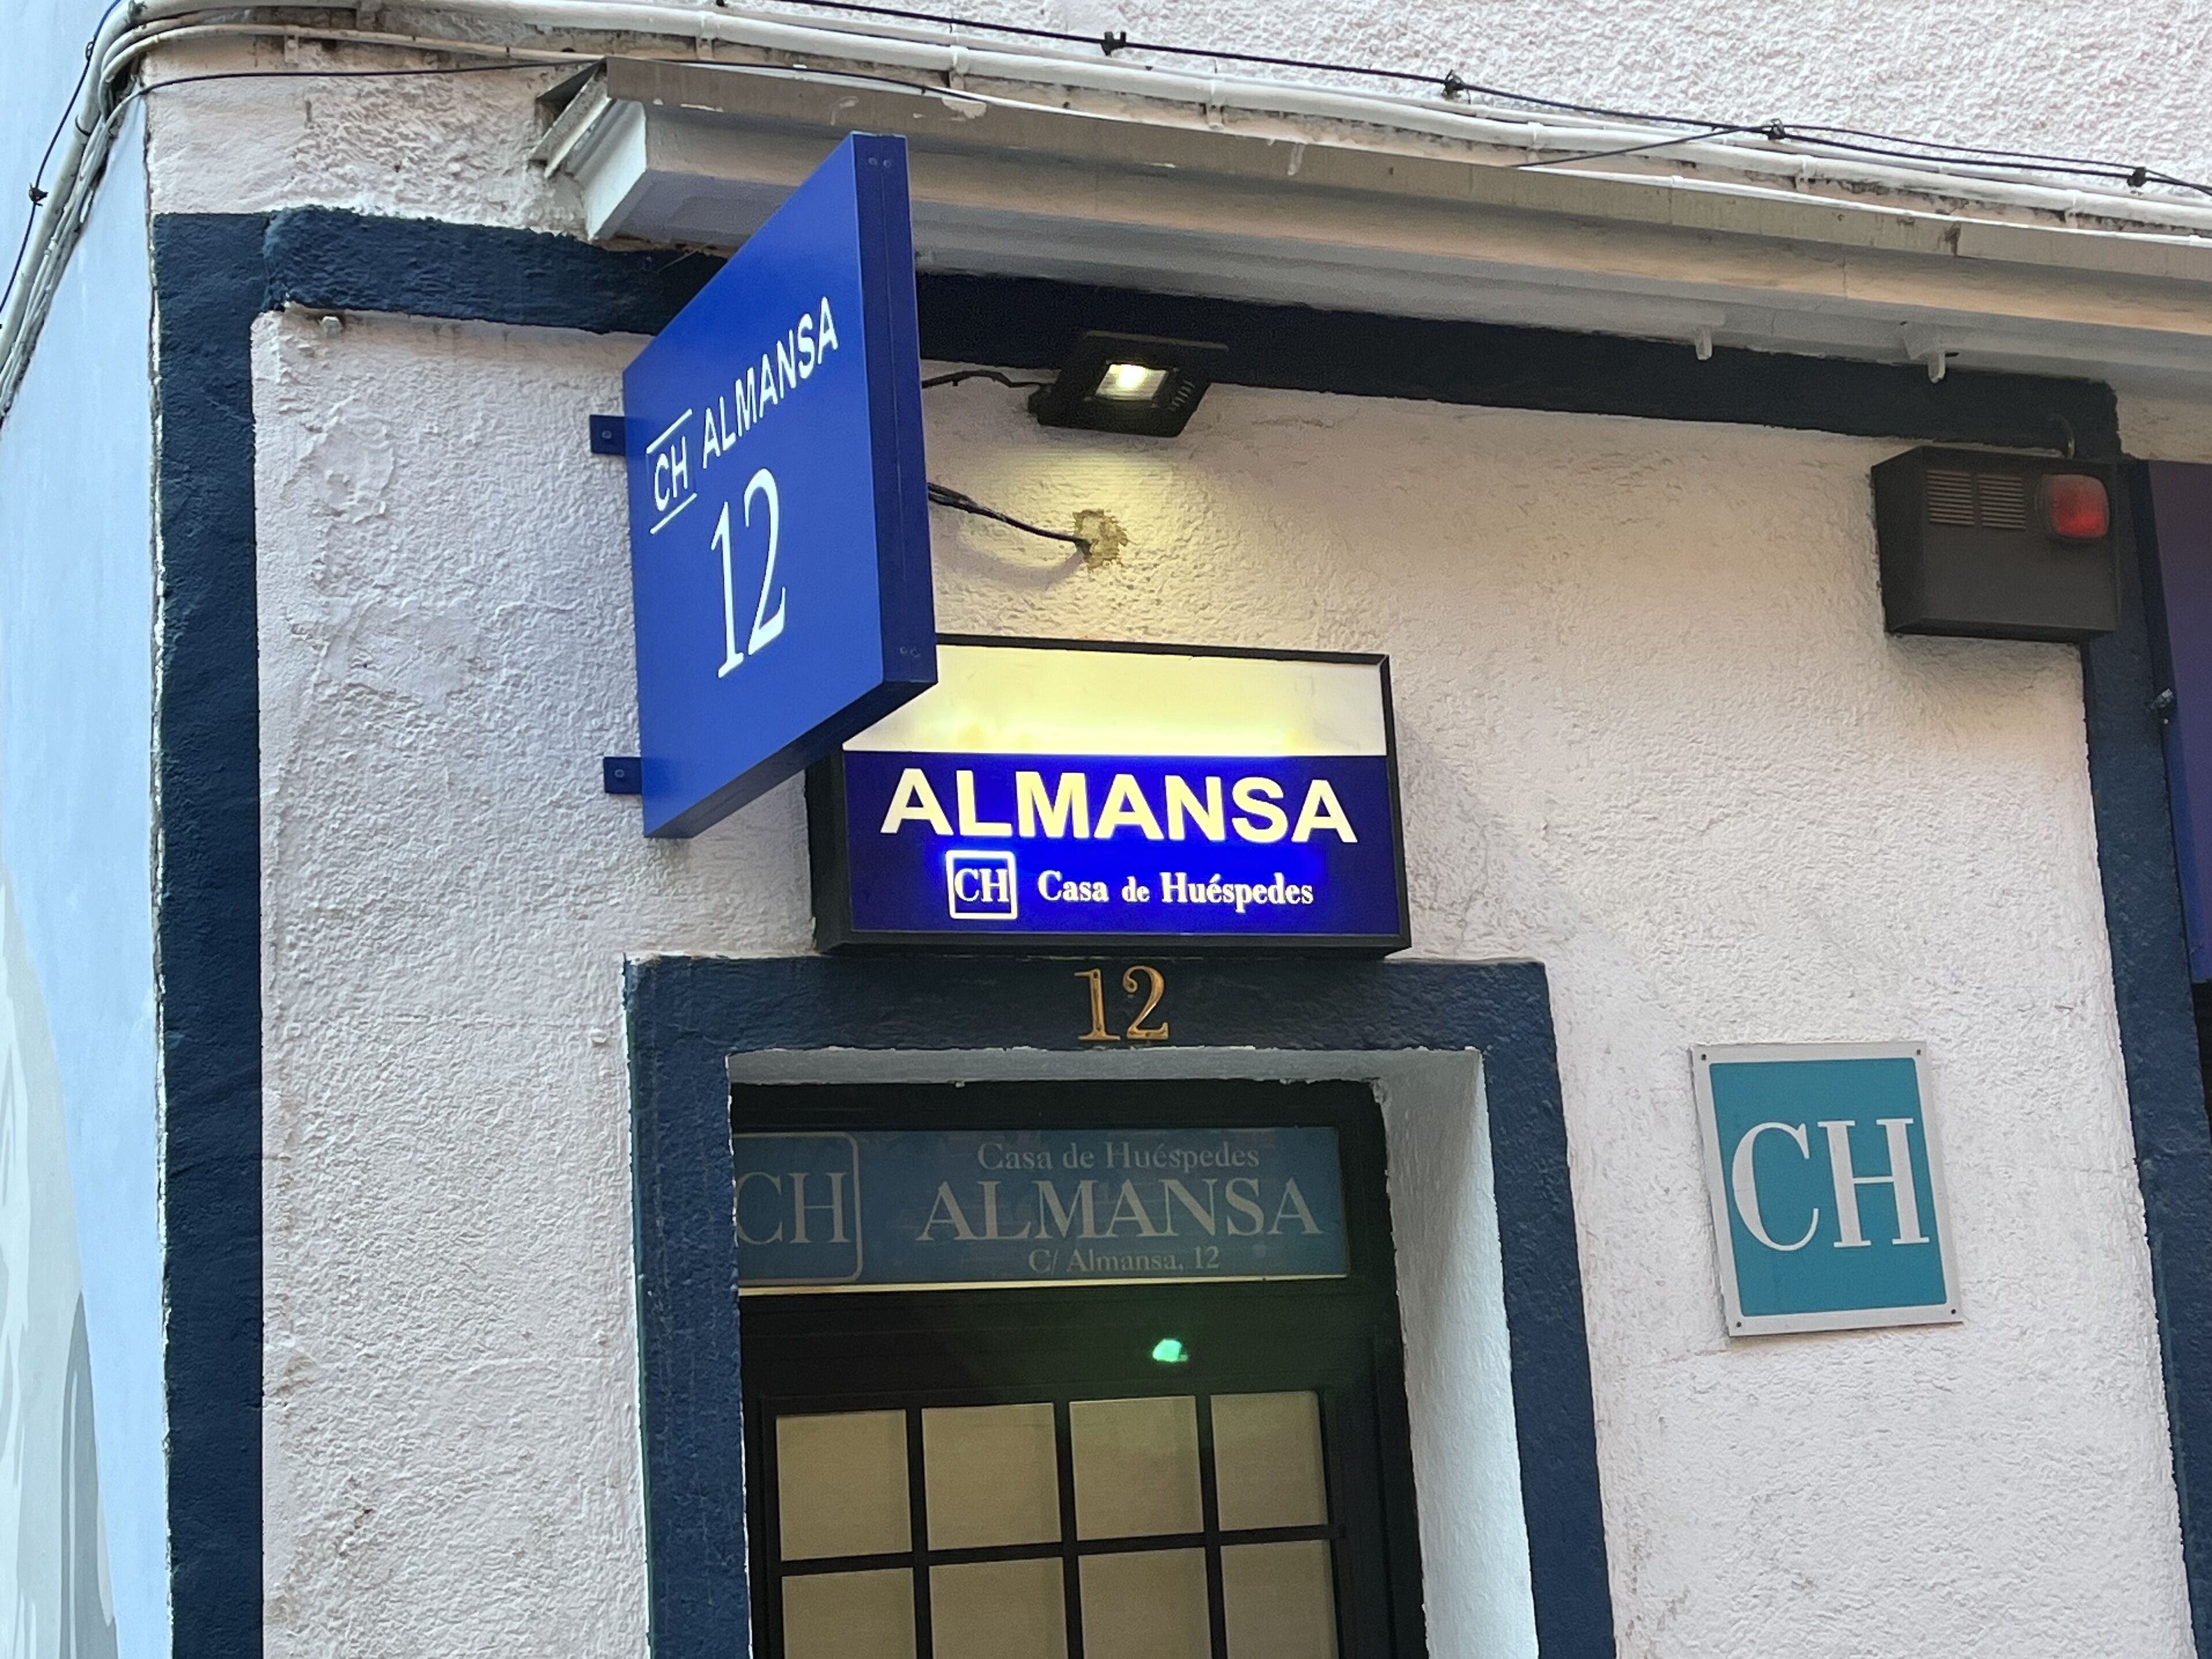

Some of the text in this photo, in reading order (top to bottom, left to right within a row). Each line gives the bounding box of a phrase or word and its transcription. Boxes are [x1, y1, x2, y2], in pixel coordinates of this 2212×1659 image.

[653, 297, 839, 511] CH ALMANSA
[711, 468, 787, 678] 12
[880, 768, 1358, 843] ALMANSA
[953, 868, 1010, 903] CH
[1037, 870, 1314, 914] Casa de Huéspedes
[1073, 964, 1170, 1040] 12
[977, 1141, 1260, 1172] Casa de Huéspedes
[1732, 1118, 1930, 1251] CH
[736, 1172, 850, 1244] CH
[915, 1177, 1325, 1241] ALMANSA
[1028, 1245, 1220, 1274] C/ Almansa, 12
